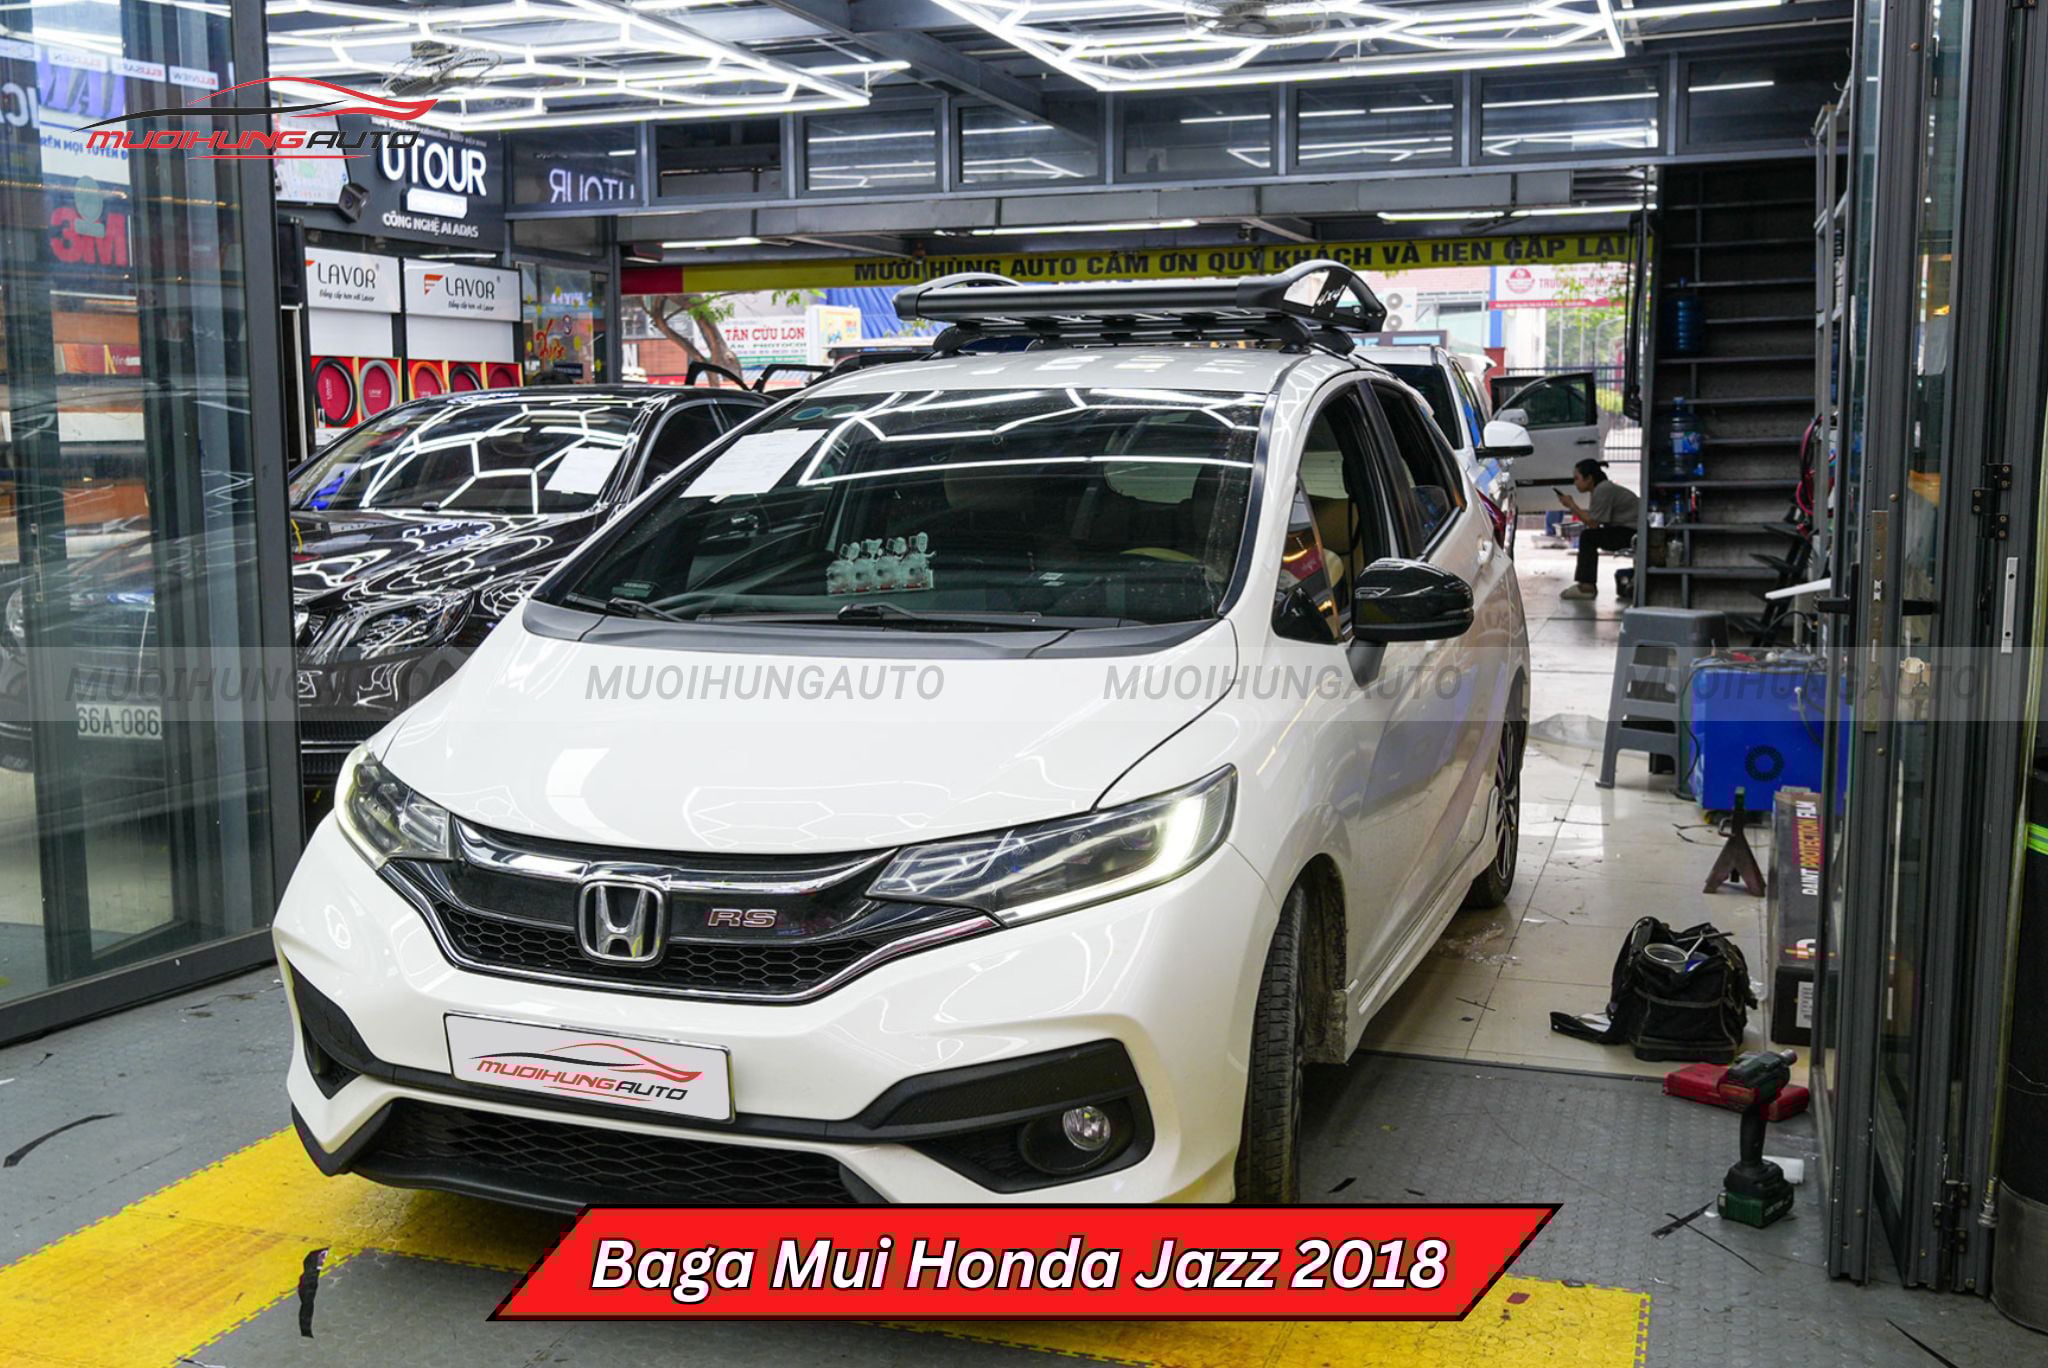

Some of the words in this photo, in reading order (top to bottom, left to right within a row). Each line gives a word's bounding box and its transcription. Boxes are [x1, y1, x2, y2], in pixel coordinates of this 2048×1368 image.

[381, 133, 487, 196] UTOUR
[50, 207, 129, 267] 3M
[382, 210, 412, 230] CÔNG
[452, 223, 480, 238] ADAS
[1010, 257, 1078, 277] AUTO
[1086, 250, 1149, 274] CẢM
[1158, 251, 1199, 273] ƠN
[1273, 244, 1372, 269] KHÁCH
[1382, 240, 1421, 265] VÀ
[1430, 240, 1493, 266] HẸN
[317, 261, 377, 289] LAVOR
[445, 276, 496, 300] LAVOR
[724, 326, 749, 342] TÂN
[78, 706, 161, 736] 66A-086
[708, 908, 778, 928] RS
